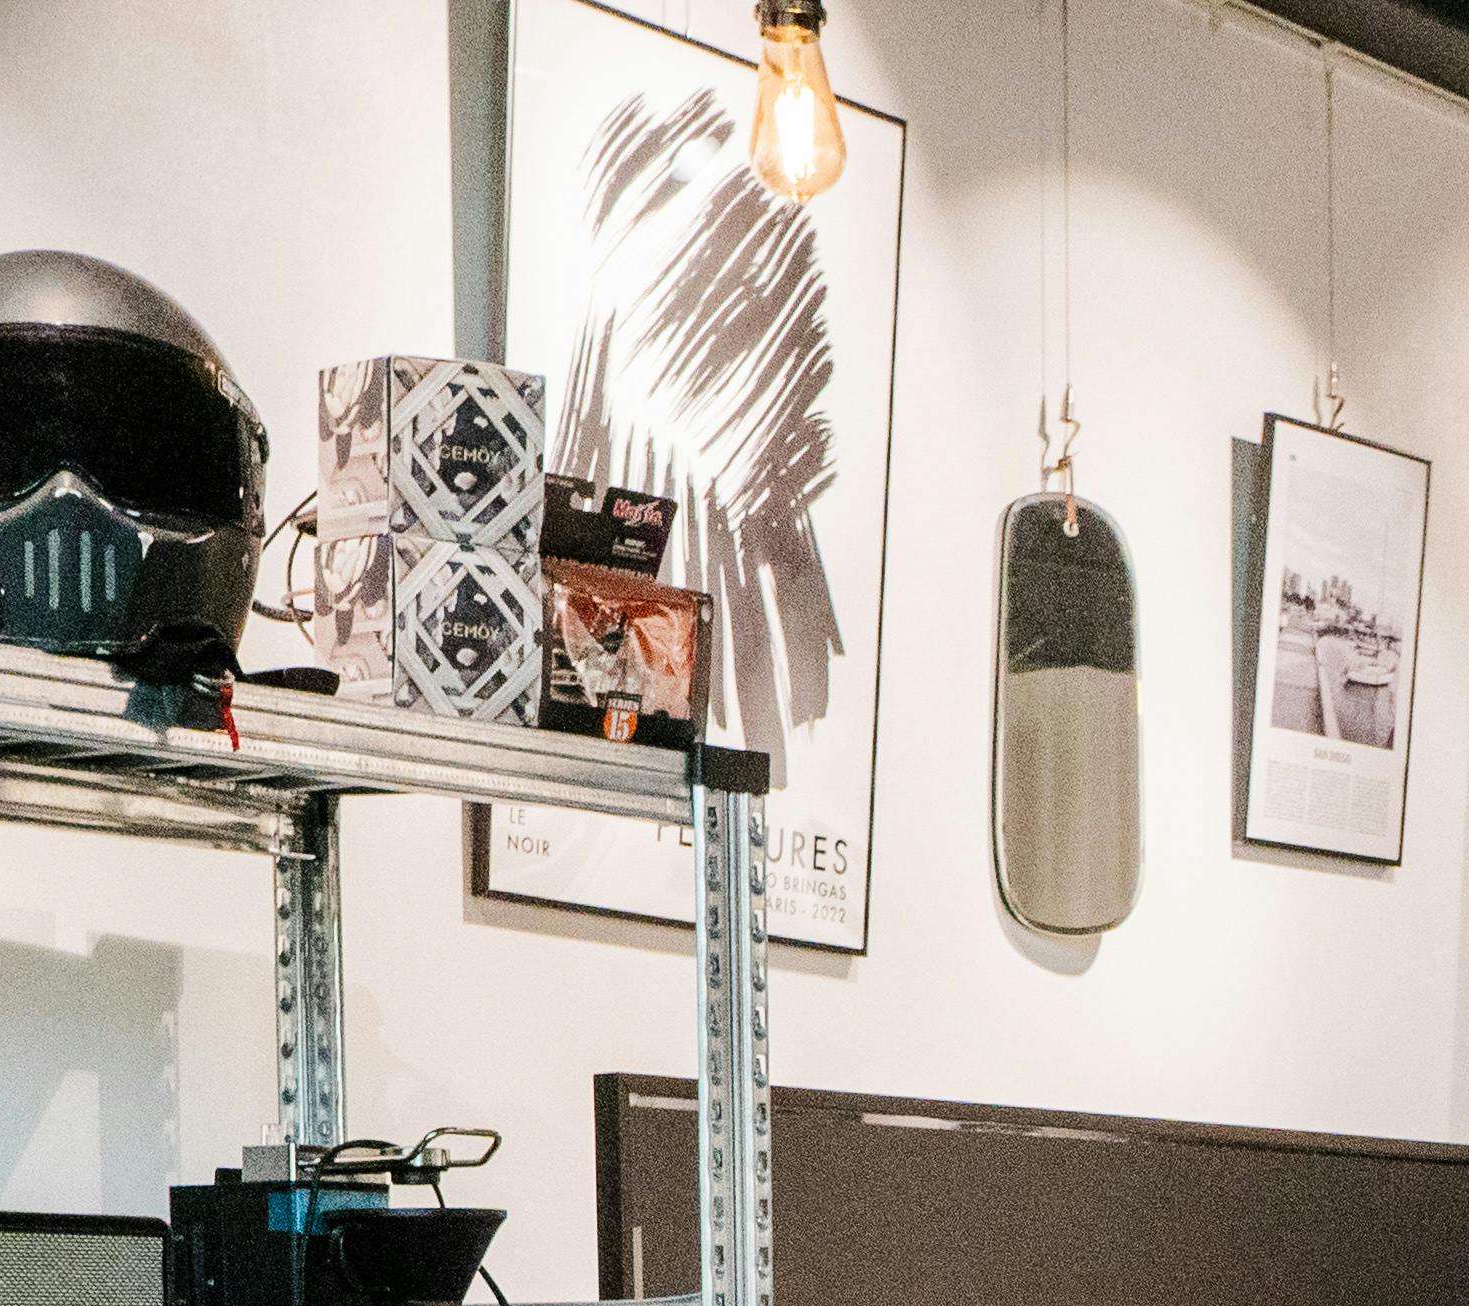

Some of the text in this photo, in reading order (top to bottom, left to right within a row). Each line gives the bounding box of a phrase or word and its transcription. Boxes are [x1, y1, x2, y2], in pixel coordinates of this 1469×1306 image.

[510, 808, 525, 825] LE
[507, 835, 550, 857] NOIR
[784, 876, 847, 901] BRINGAS
[812, 904, 847, 924] 2022
